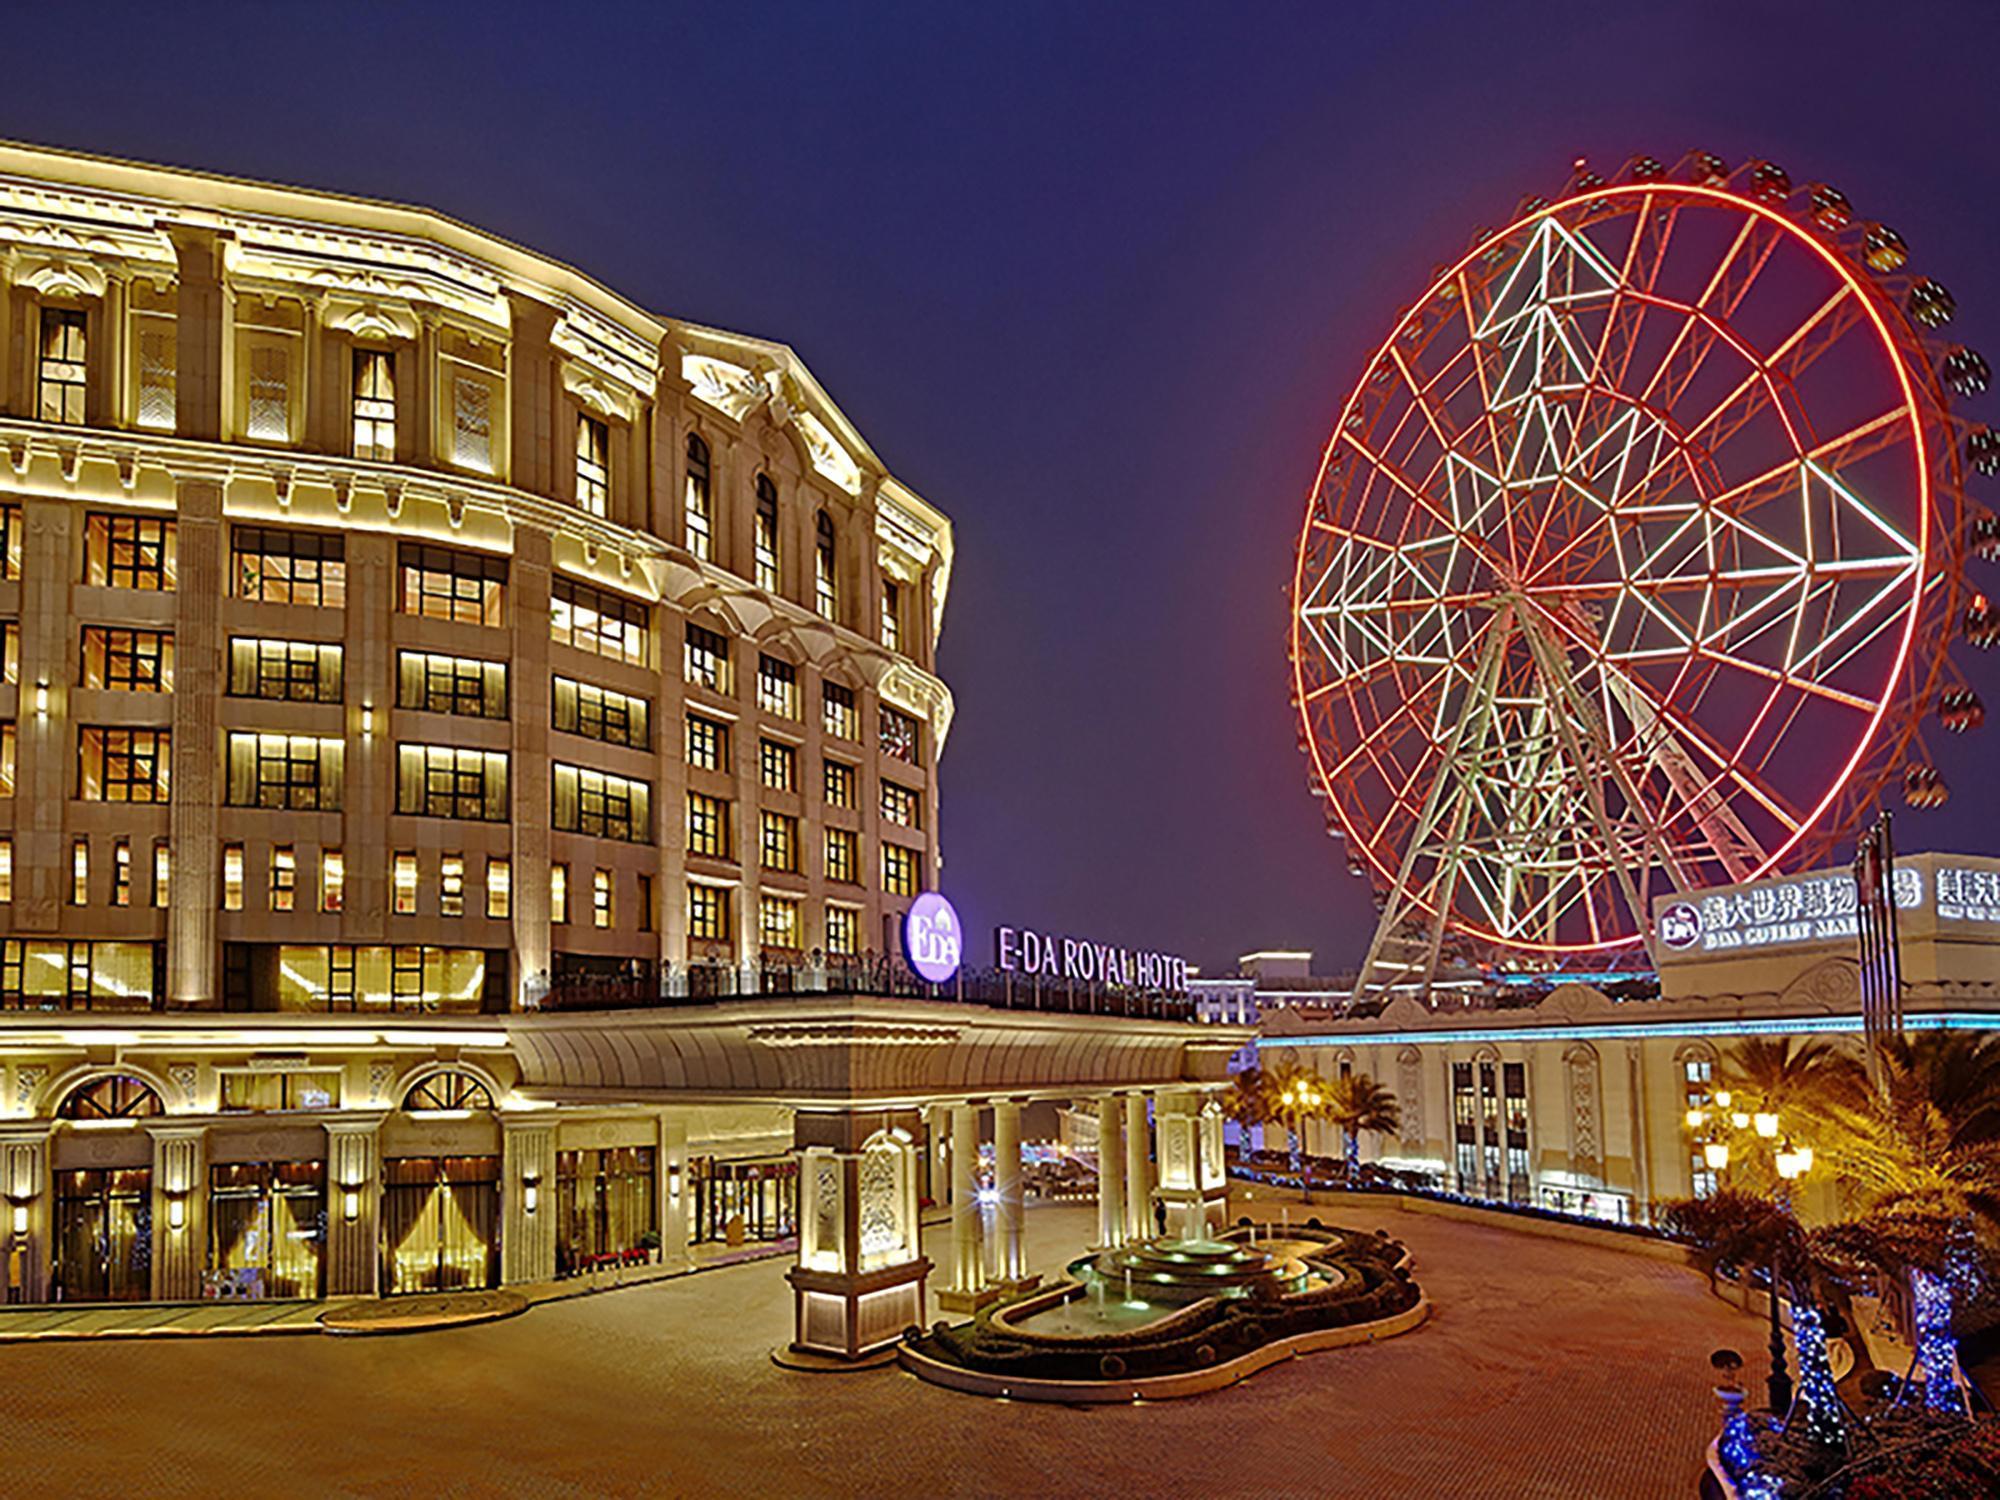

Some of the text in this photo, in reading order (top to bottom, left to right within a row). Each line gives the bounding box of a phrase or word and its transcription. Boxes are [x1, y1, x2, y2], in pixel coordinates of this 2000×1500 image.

[911, 914, 960, 966] EDA
[1000, 927, 1190, 992] E-DA ROYAL HOTEL
